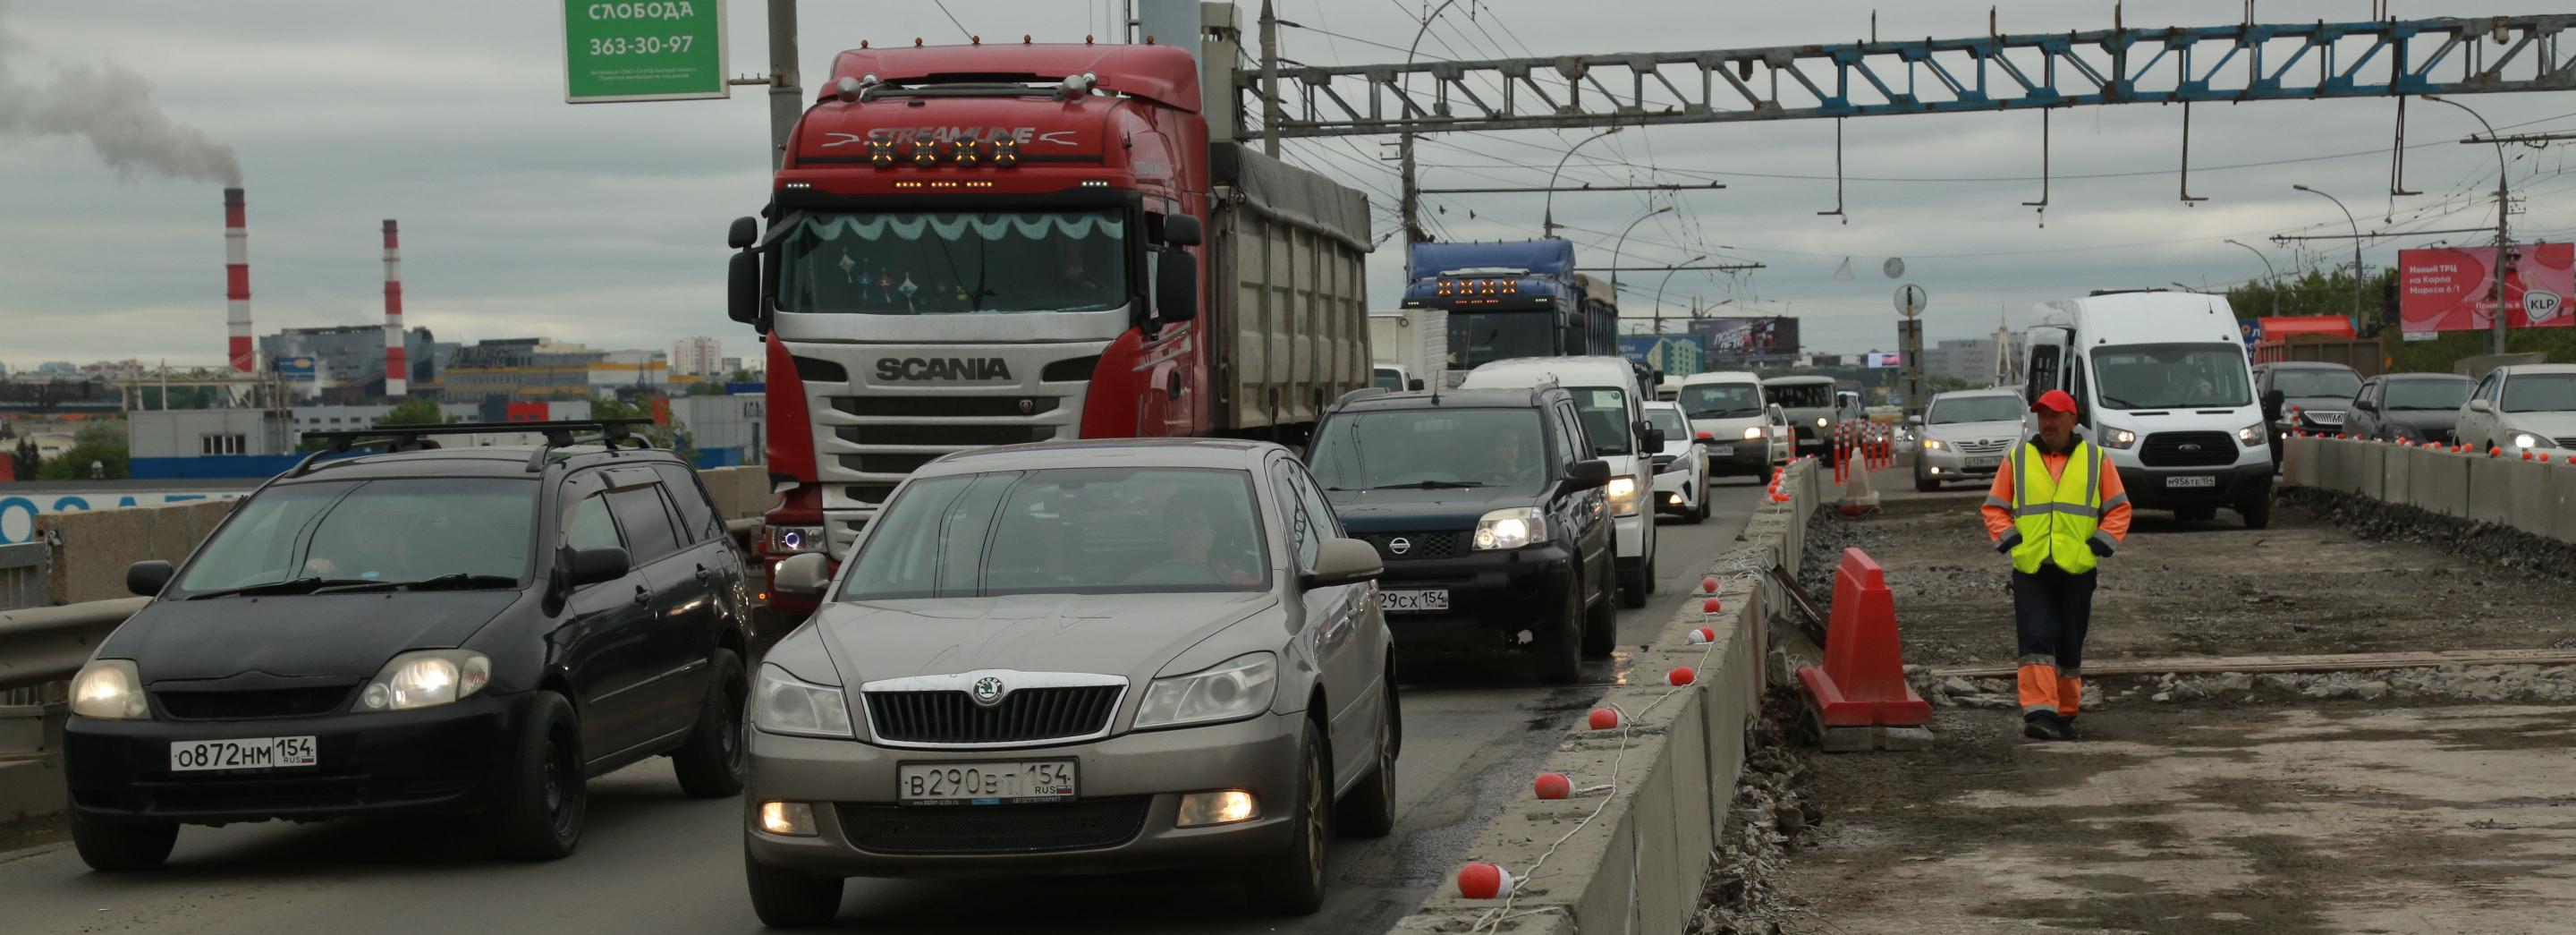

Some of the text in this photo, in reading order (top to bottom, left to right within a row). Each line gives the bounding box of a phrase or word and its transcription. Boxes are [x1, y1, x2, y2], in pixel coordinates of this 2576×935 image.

[589, 1, 694, 21] СЛОБОДА
[589, 36, 694, 55] 363-30-97
[863, 127, 1036, 145] STREAMLINE
[2410, 264, 2458, 274] Новый ТРЦ
[2423, 276, 2451, 285] Карла
[2410, 285, 2460, 296] Маркса 6/1
[2530, 300, 2555, 310] KLP
[876, 358, 1013, 380] SCANIA
[1421, 591, 1445, 603] 154
[178, 738, 311, 768] О872НМ 154
[1035, 786, 1057, 795] RUS
